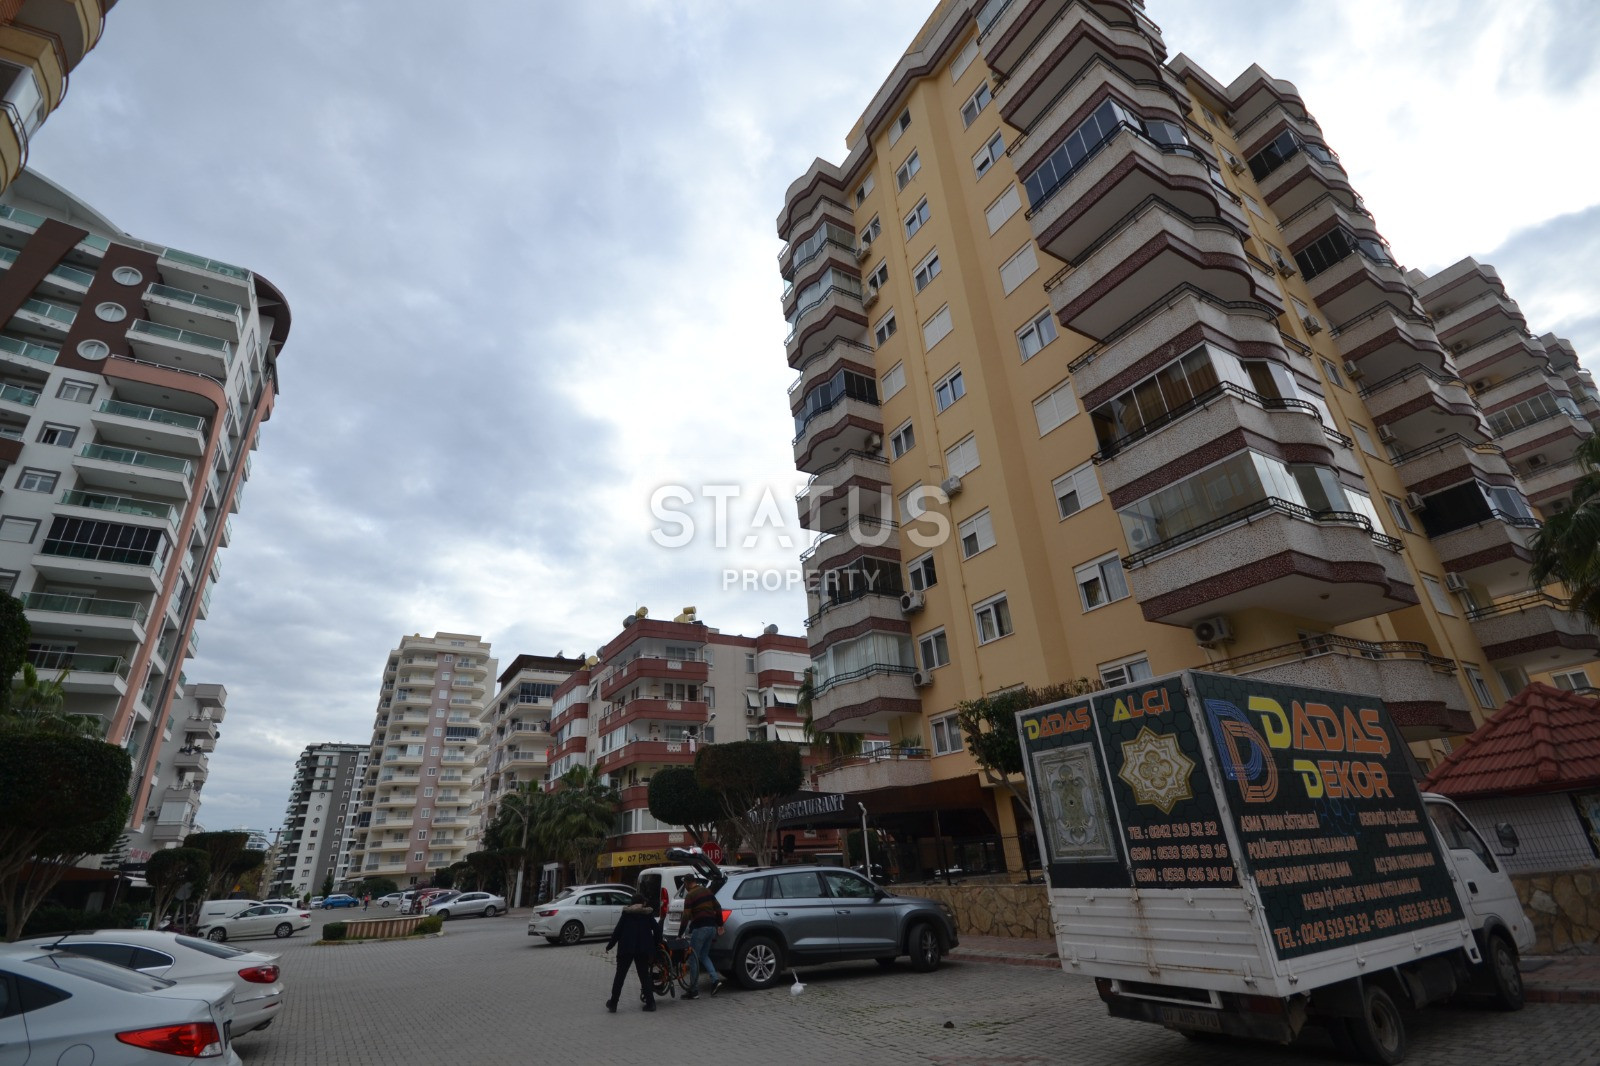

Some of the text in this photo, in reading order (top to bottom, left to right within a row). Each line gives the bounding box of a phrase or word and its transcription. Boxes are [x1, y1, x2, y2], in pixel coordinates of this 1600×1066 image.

[1112, 687, 1171, 722] ALÇI
[1023, 706, 1091, 740] DADAŞ
[1248, 695, 1391, 759] DADAŞ
[1293, 759, 1395, 799] DEKOR
[778, 793, 845, 820] RESTAURANT
[1128, 826, 1144, 840] TEL
[1149, 824, 1172, 839] 0242
[1172, 822, 1190, 838] 519
[1191, 822, 1204, 837] 52
[1204, 821, 1218, 836] 32
[627, 854, 637, 862] 07
[1130, 846, 1152, 861] GSM
[1157, 845, 1180, 860] 0533
[1180, 844, 1199, 859] 336
[1200, 844, 1213, 859] 33
[1214, 843, 1228, 858] 16
[1135, 867, 1157, 882] GSM
[1162, 867, 1186, 882] 0533
[1187, 867, 1205, 882] 436
[1206, 866, 1220, 881] 34
[1220, 866, 1233, 881] 07
[1255, 869, 1280, 887] PROJE
[1306, 863, 1319, 882] VE
[1273, 926, 1296, 949] TEL
[1301, 920, 1328, 945] 0242
[1325, 917, 1346, 940] 519
[1344, 914, 1359, 936] 52
[1357, 912, 1371, 933] 32
[1374, 908, 1396, 929] GSM
[1398, 903, 1420, 924] 0533
[1417, 900, 1434, 920] 336
[1431, 898, 1443, 917] 33
[1440, 896, 1452, 914] 16
